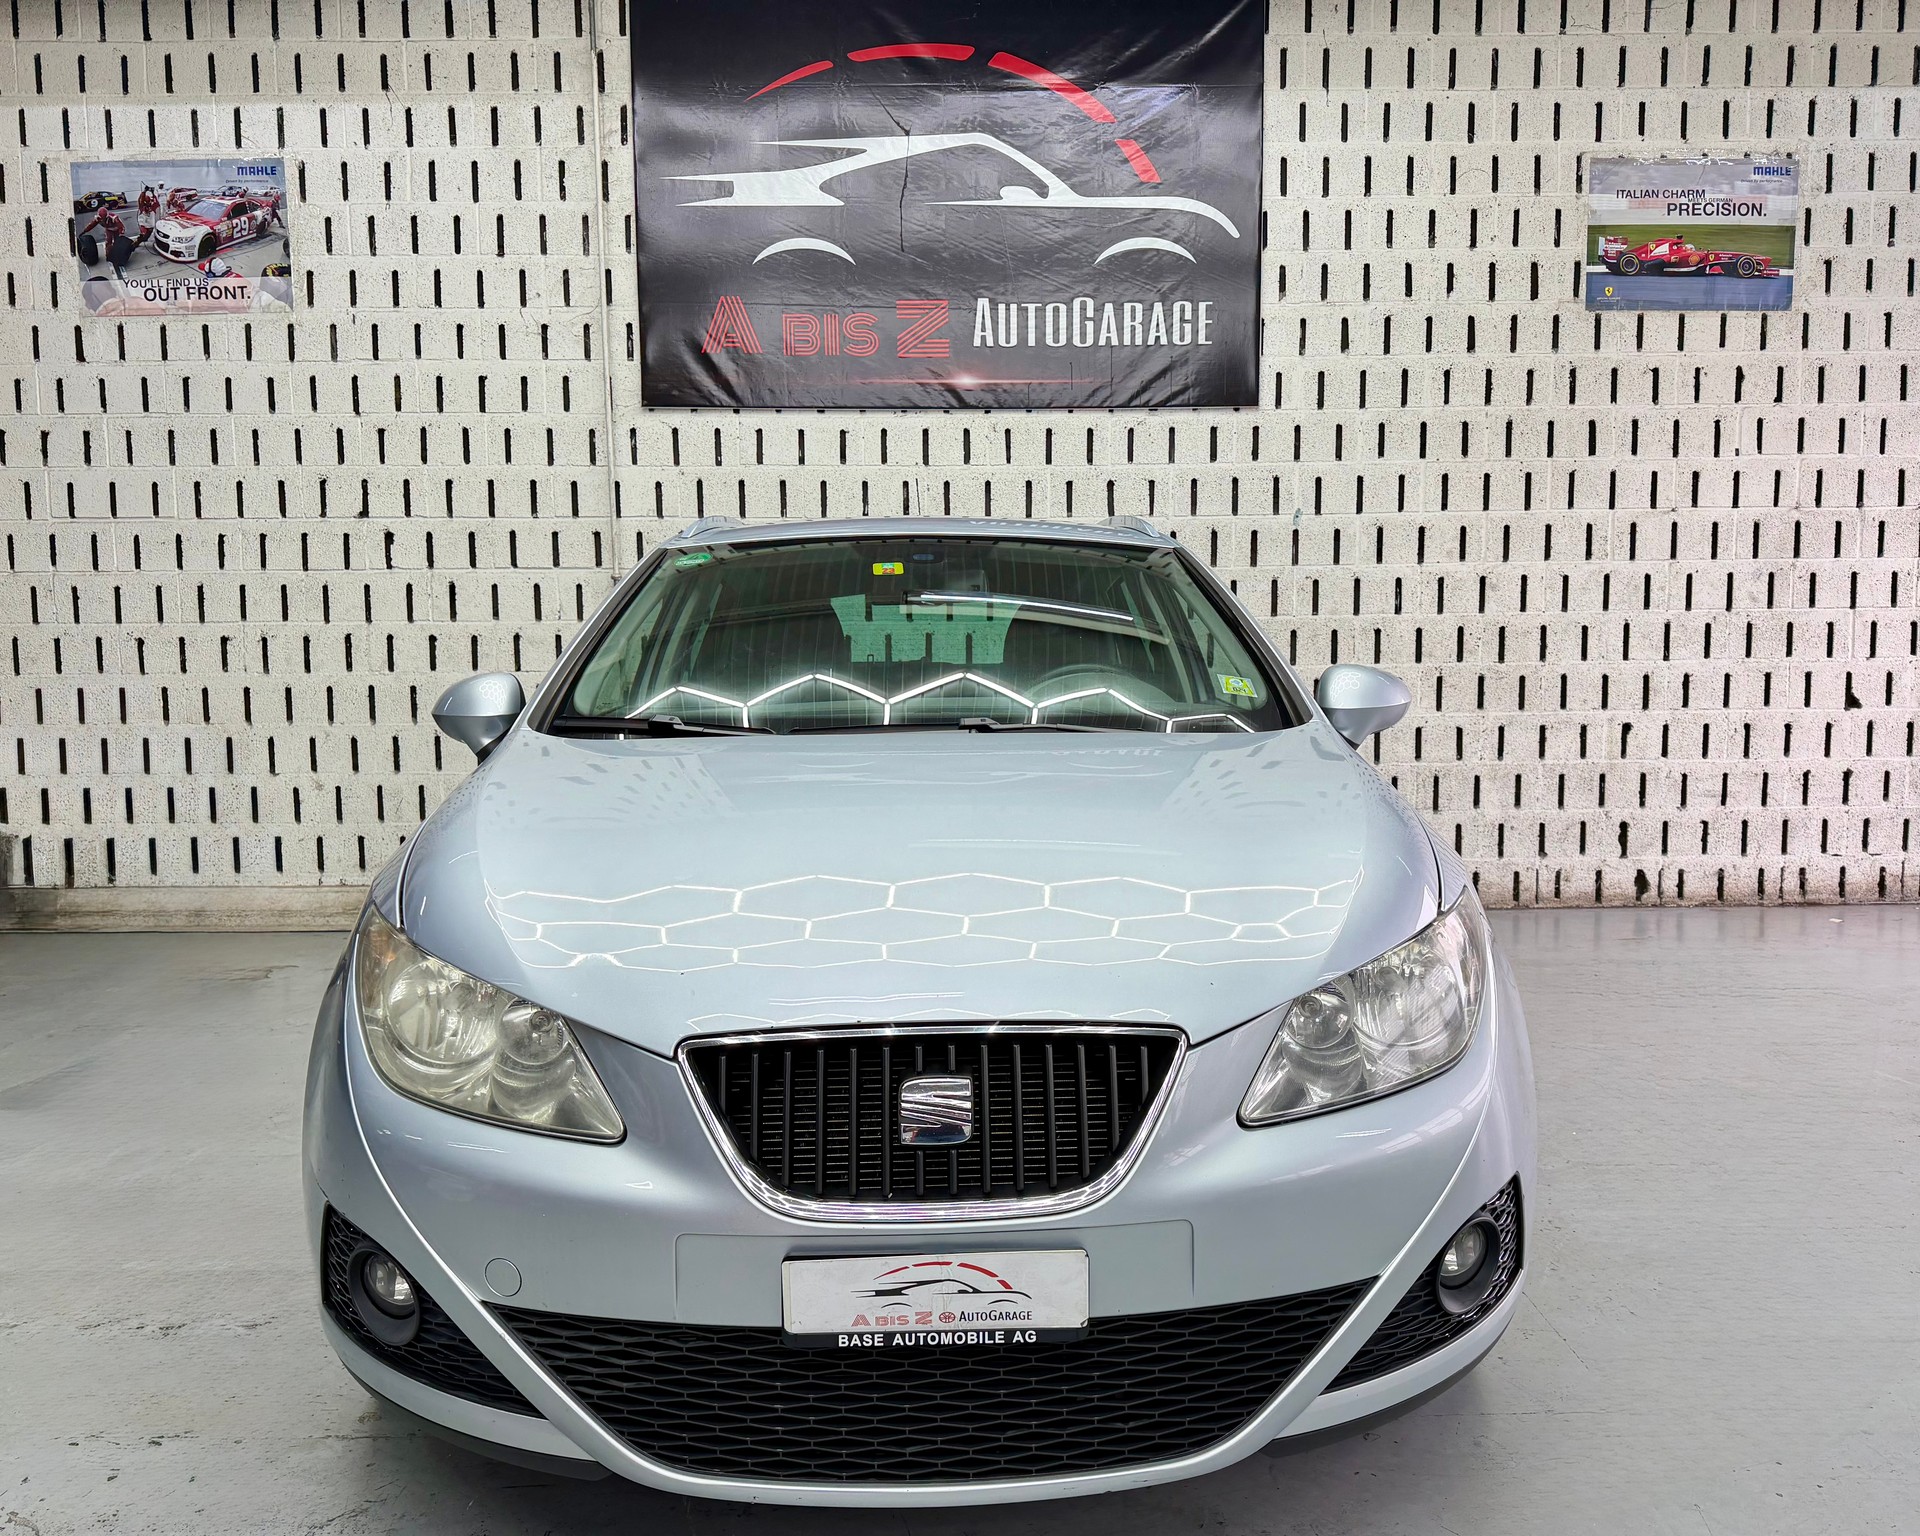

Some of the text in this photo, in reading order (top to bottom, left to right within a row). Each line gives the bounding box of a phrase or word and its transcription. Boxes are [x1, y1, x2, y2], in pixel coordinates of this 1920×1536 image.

[237, 166, 277, 176] MAHLE
[1753, 166, 1791, 176] MAHLE
[1616, 189, 1706, 199] ITALIAN CHARM
[1666, 202, 1767, 217] PRECISION.
[232, 216, 249, 239] 29
[123, 277, 209, 288] YOU'LL FIND US
[144, 286, 251, 301] OUT FRONT.
[701, 295, 763, 354] A
[896, 299, 950, 358] Z
[850, 1314, 872, 1327] A
[914, 1311, 933, 1325] Z
[837, 1330, 1037, 1347] BASE AUTOMOBILE AG
